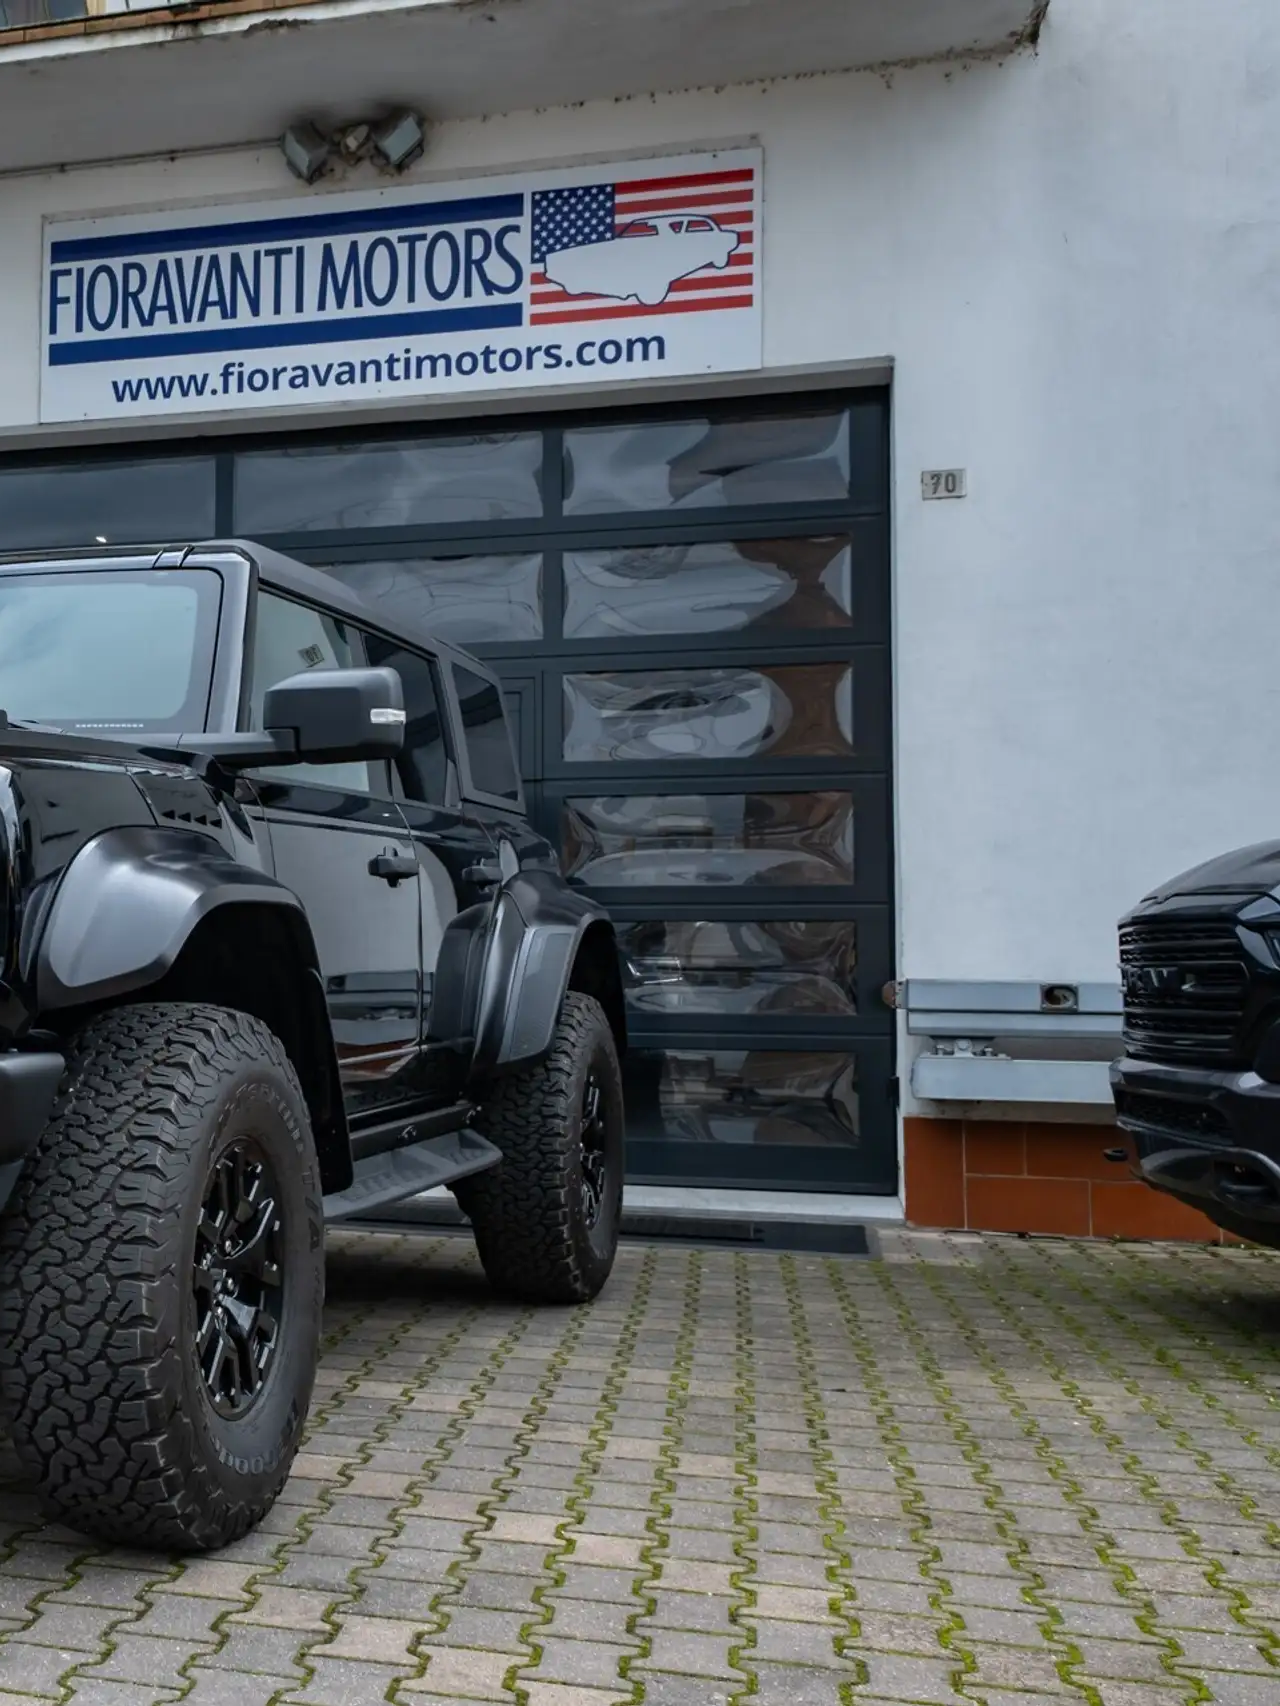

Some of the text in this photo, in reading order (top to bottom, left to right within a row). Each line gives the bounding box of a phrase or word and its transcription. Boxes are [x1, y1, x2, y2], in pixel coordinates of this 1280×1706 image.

[49, 224, 524, 335] FIORAVANTI MOTORS
[112, 334, 667, 403] www.fioravantimotors.com
[931, 472, 957, 495] 70
